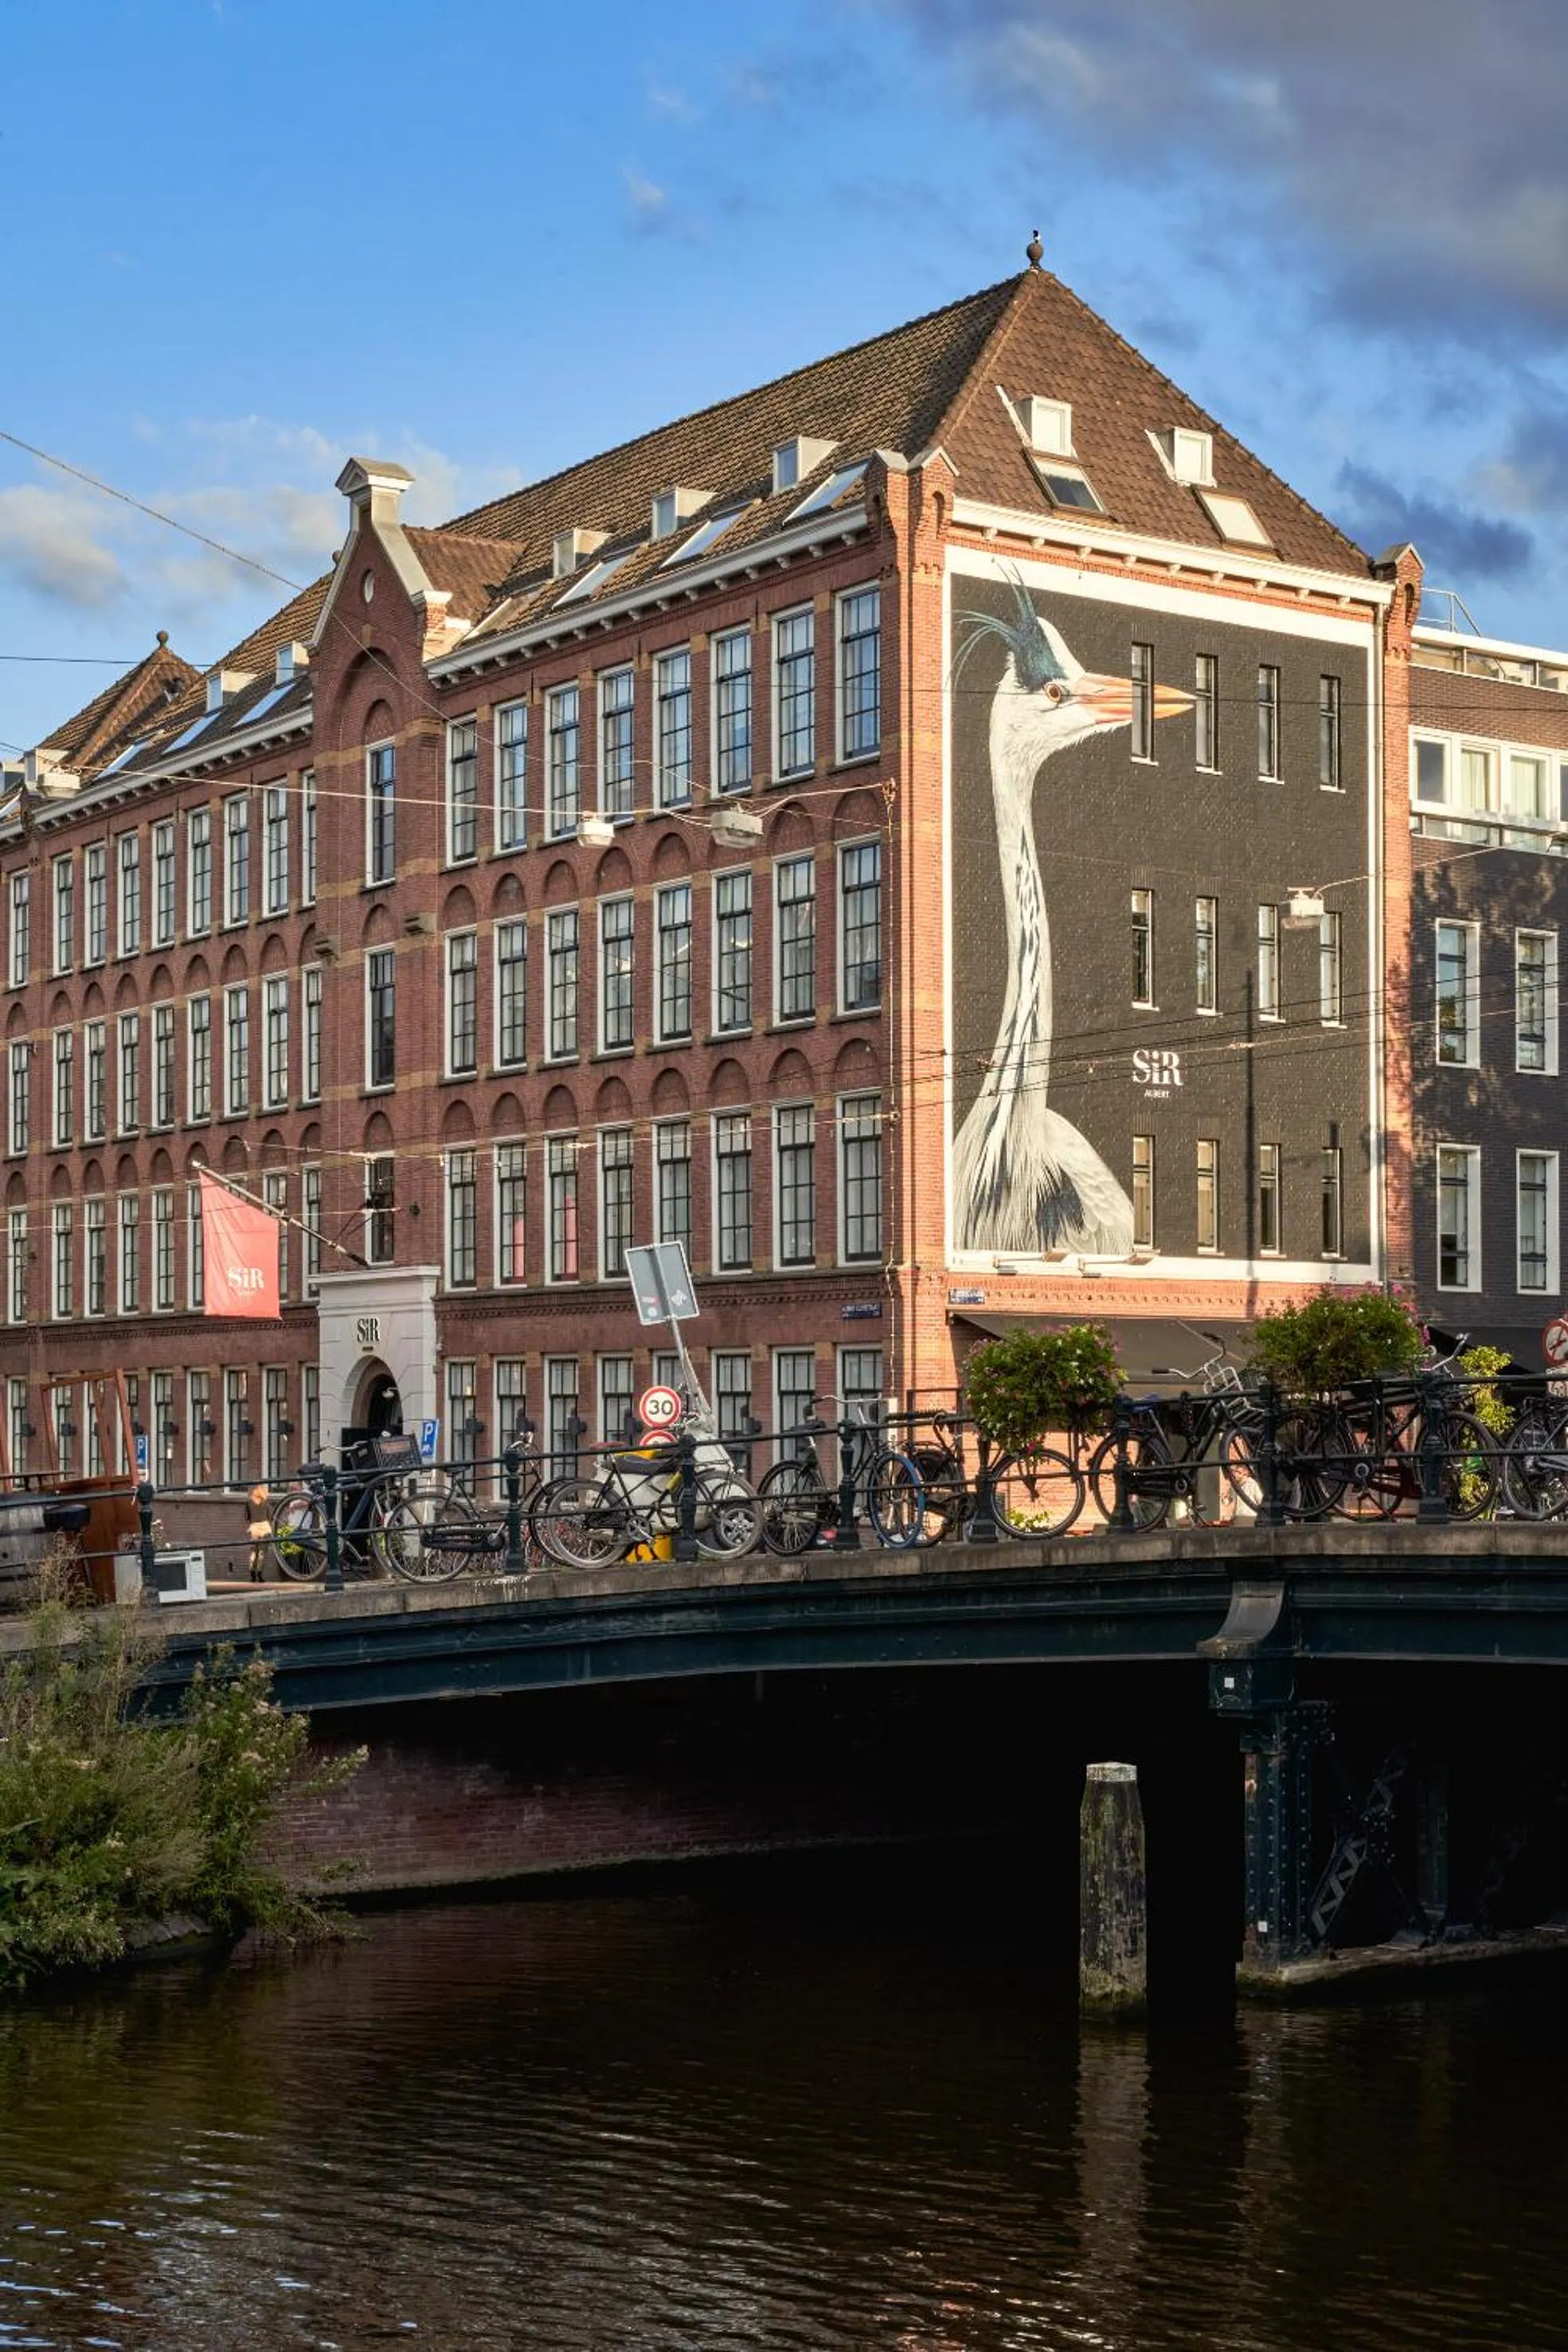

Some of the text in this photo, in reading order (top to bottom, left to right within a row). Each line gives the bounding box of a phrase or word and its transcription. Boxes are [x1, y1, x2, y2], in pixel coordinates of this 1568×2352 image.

[1144, 1089, 1170, 1098] ALBERT
[649, 1399, 674, 1415] 30
[424, 1423, 433, 1442] P
[137, 1438, 144, 1456] P
